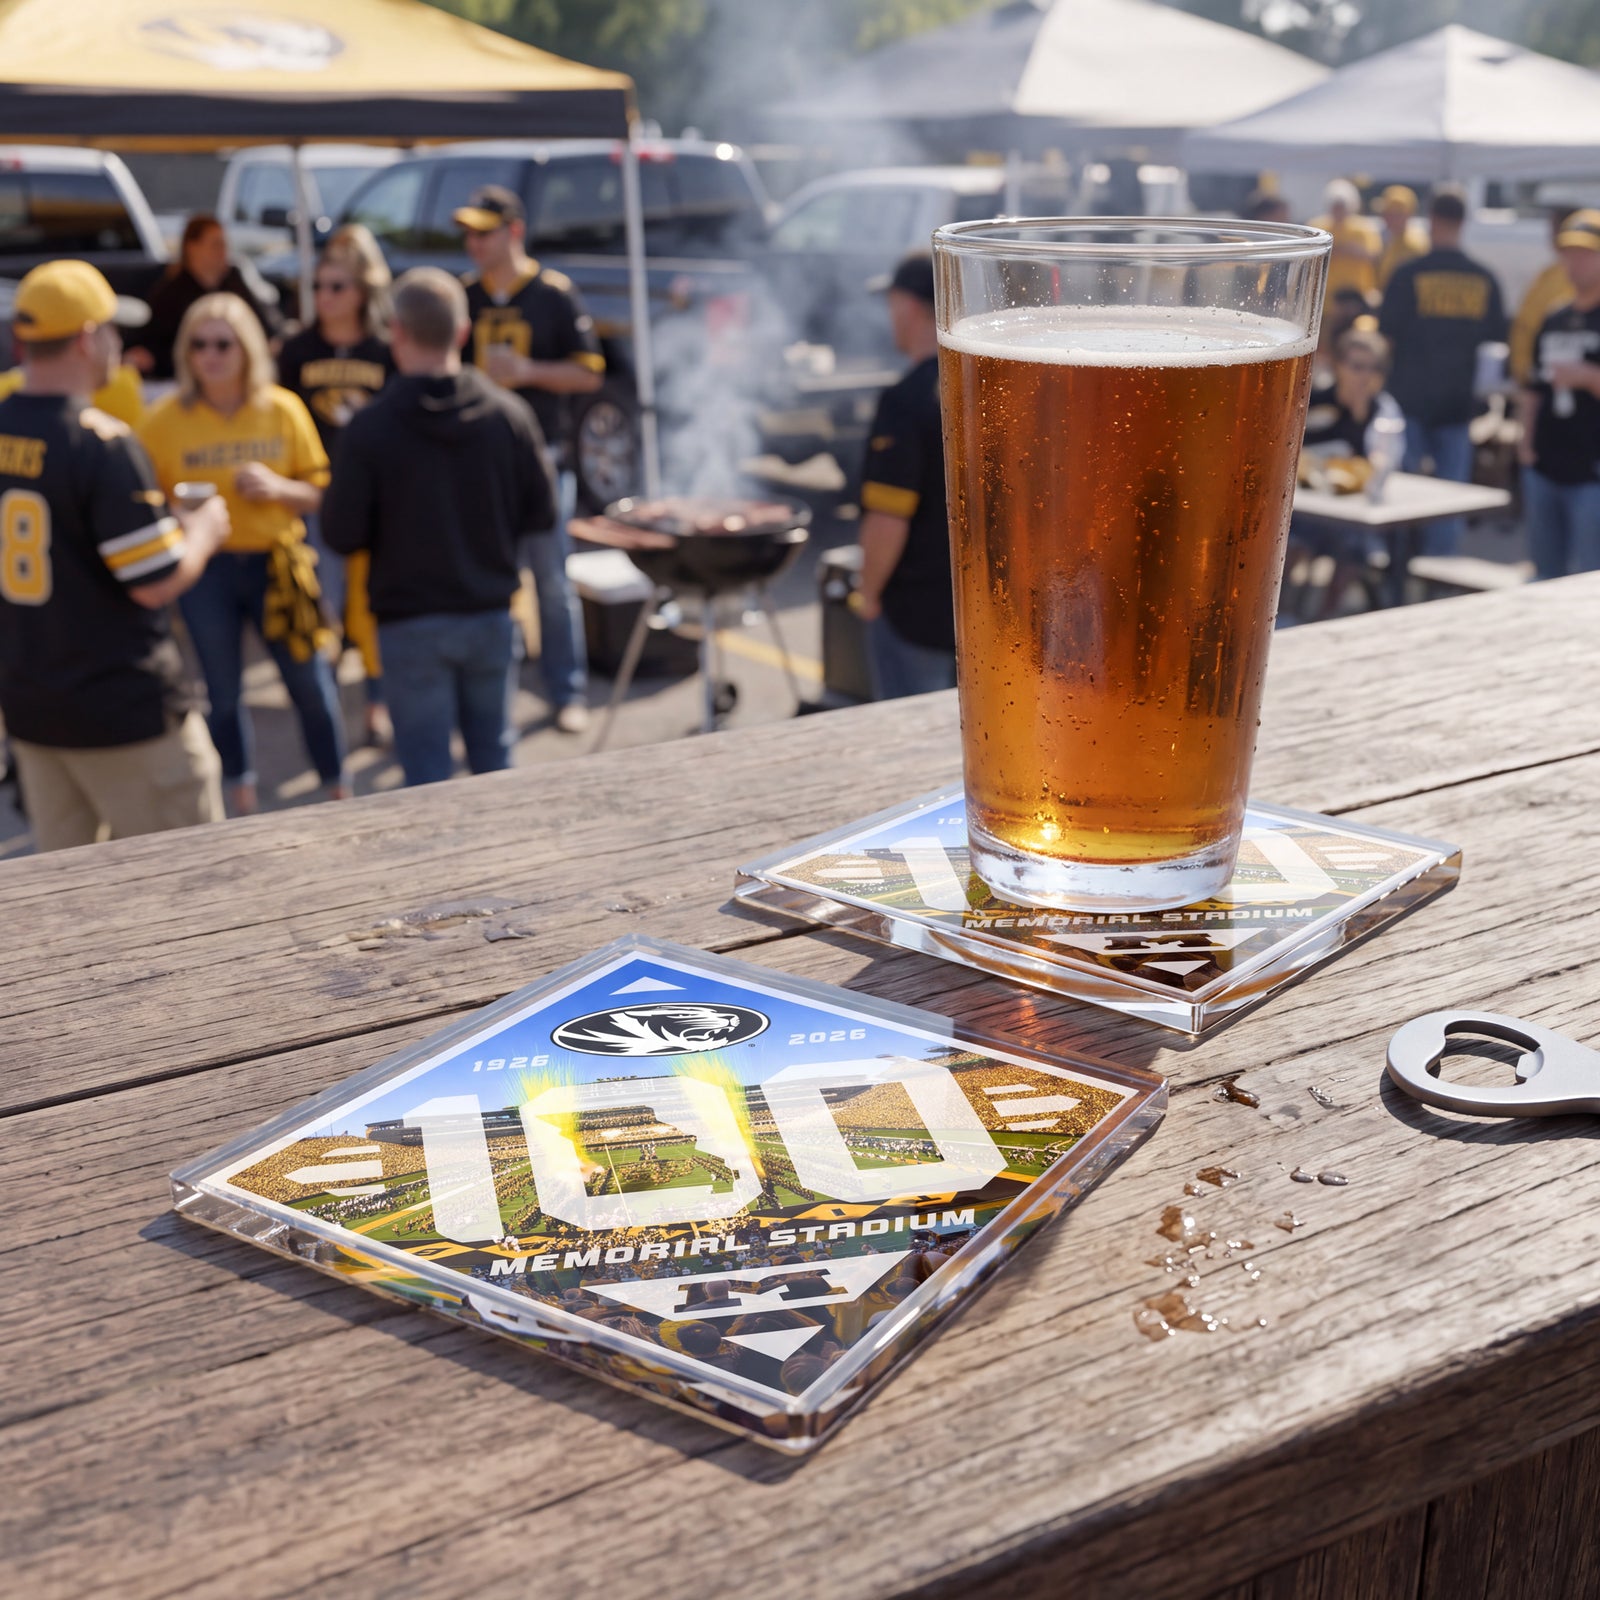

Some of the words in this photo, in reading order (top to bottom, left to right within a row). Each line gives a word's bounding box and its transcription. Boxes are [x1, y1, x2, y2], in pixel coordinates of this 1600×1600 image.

[0, 488, 53, 607] 8
[965, 914, 1151, 929] MEMORIAL
[1162, 908, 1313, 922] STADIUM
[788, 1028, 867, 1047] 2026
[472, 1054, 550, 1073] 1926
[402, 1056, 1009, 1243] 100
[489, 1234, 751, 1277] MEMORIAL
[769, 1208, 976, 1247] STADIUM
